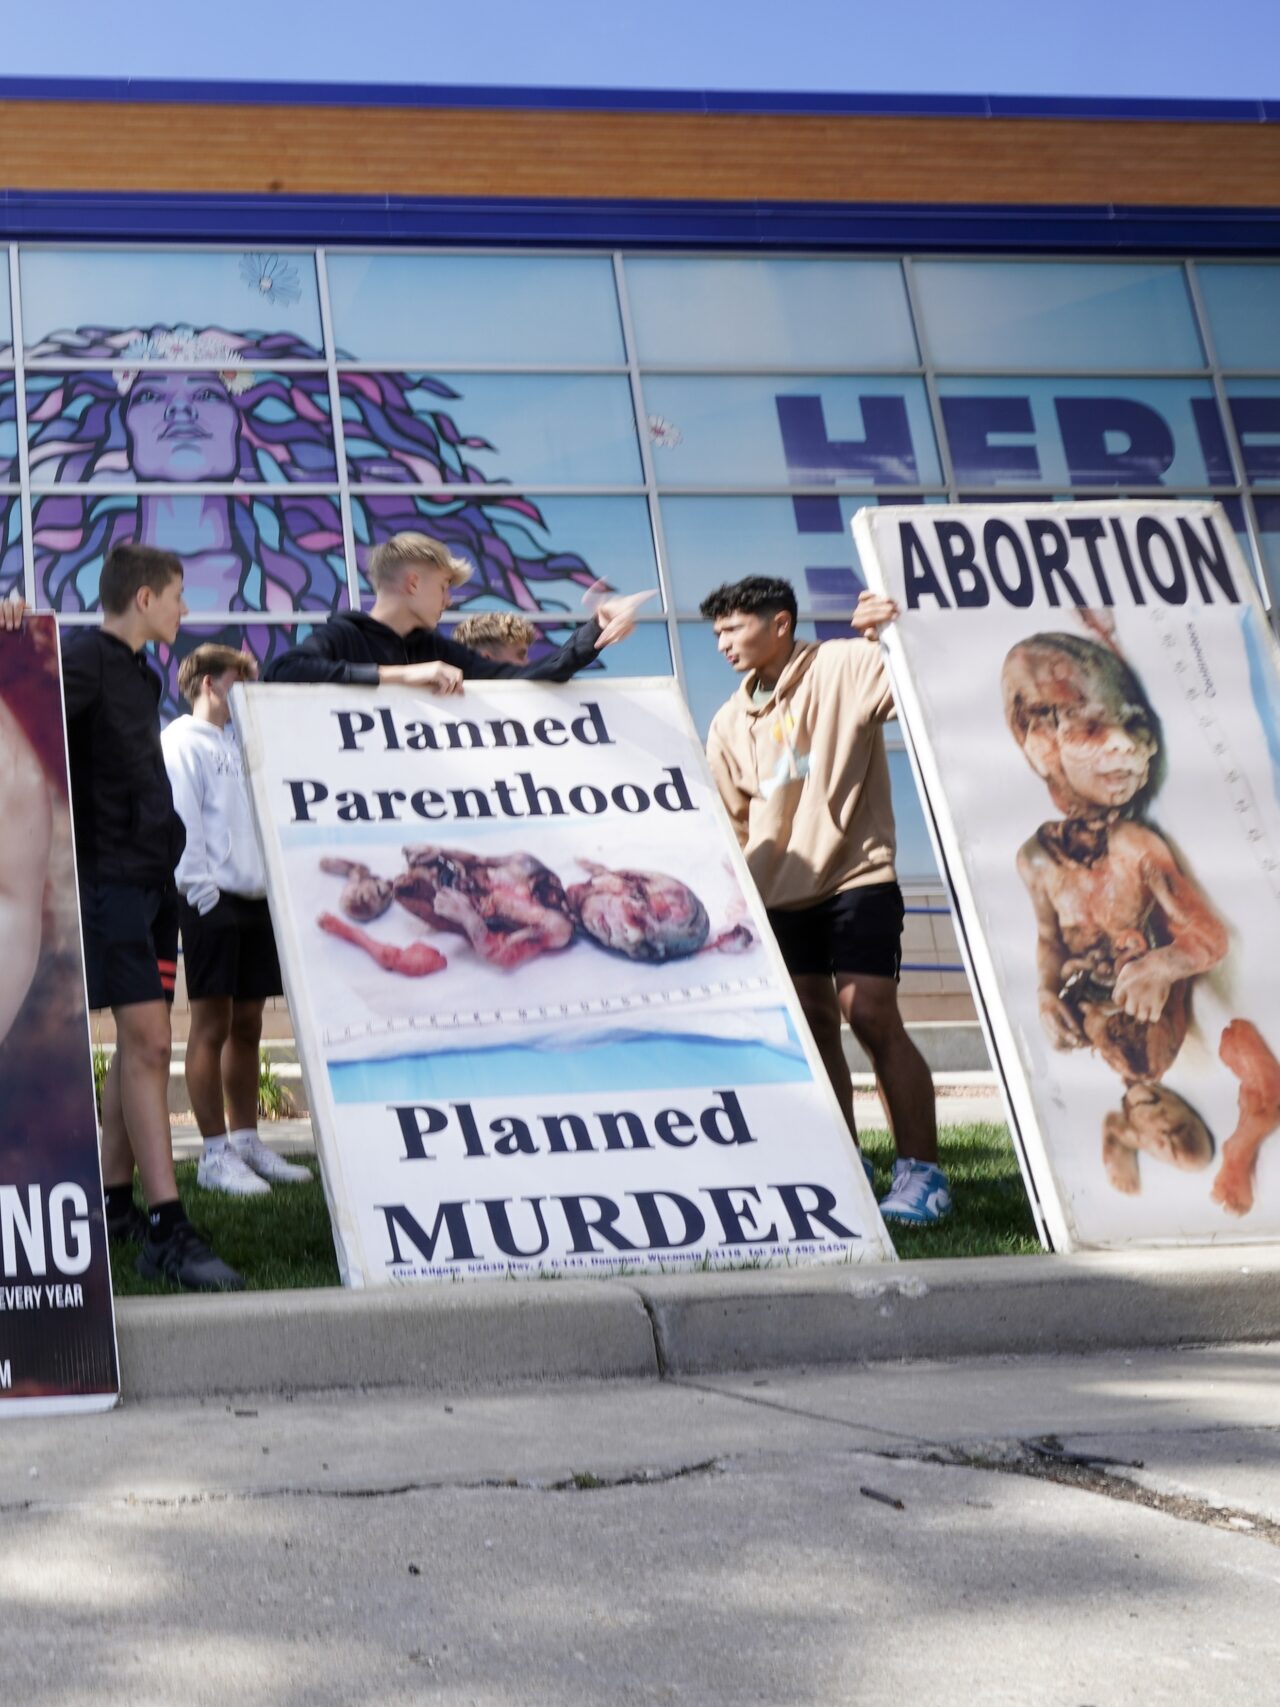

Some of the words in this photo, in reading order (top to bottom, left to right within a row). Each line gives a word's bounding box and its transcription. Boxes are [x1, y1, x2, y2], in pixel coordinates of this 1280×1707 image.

[899, 516, 1240, 611] ABORTION
[331, 701, 616, 752] Planned
[283, 767, 700, 824] Parenthood
[386, 1090, 758, 1162] Planned
[374, 1183, 862, 1268] MURDER
[44, 1283, 85, 1309] YEAR
